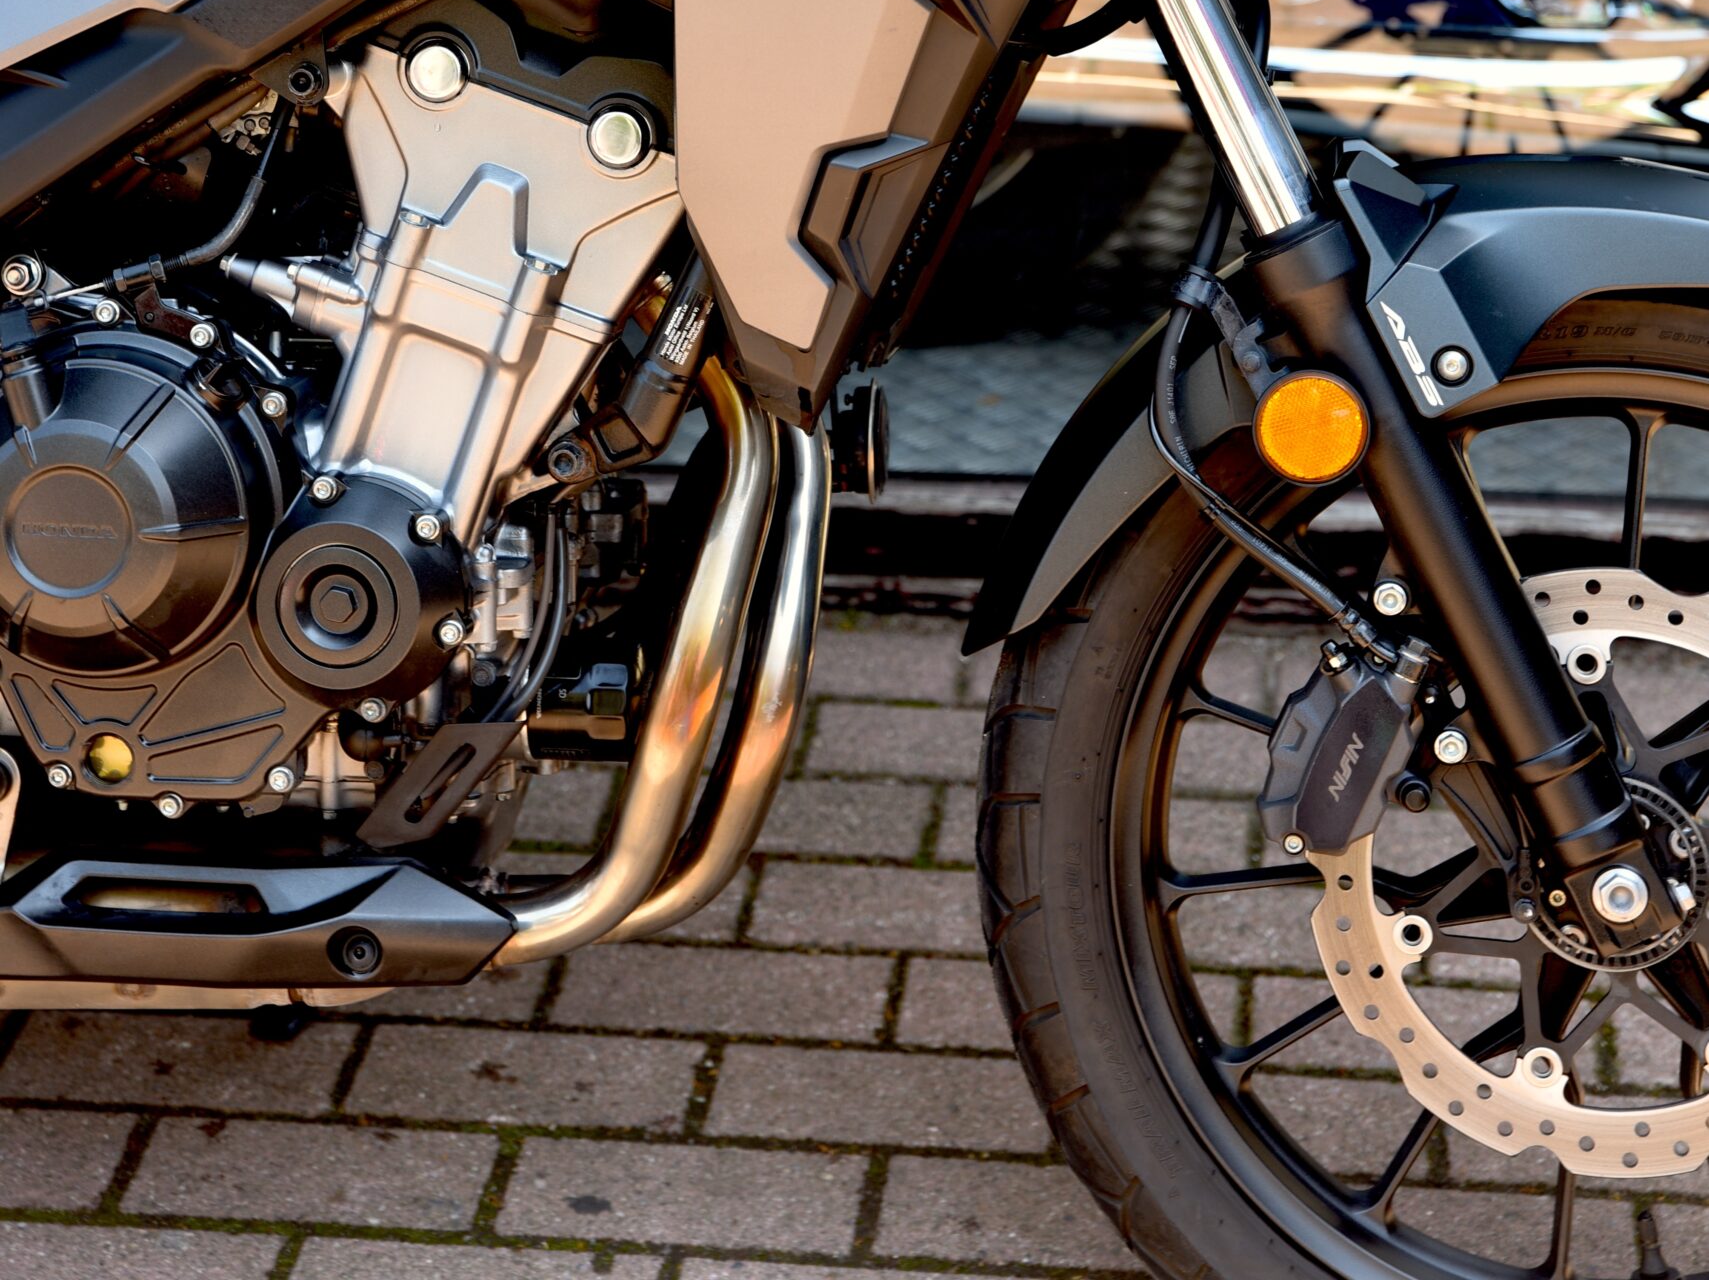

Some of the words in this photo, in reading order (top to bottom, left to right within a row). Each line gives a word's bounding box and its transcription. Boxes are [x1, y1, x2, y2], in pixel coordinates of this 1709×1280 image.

[664, 306, 682, 335] HONDA
[1380, 301, 1443, 406] ABS
[22, 522, 118, 540] HONDA
